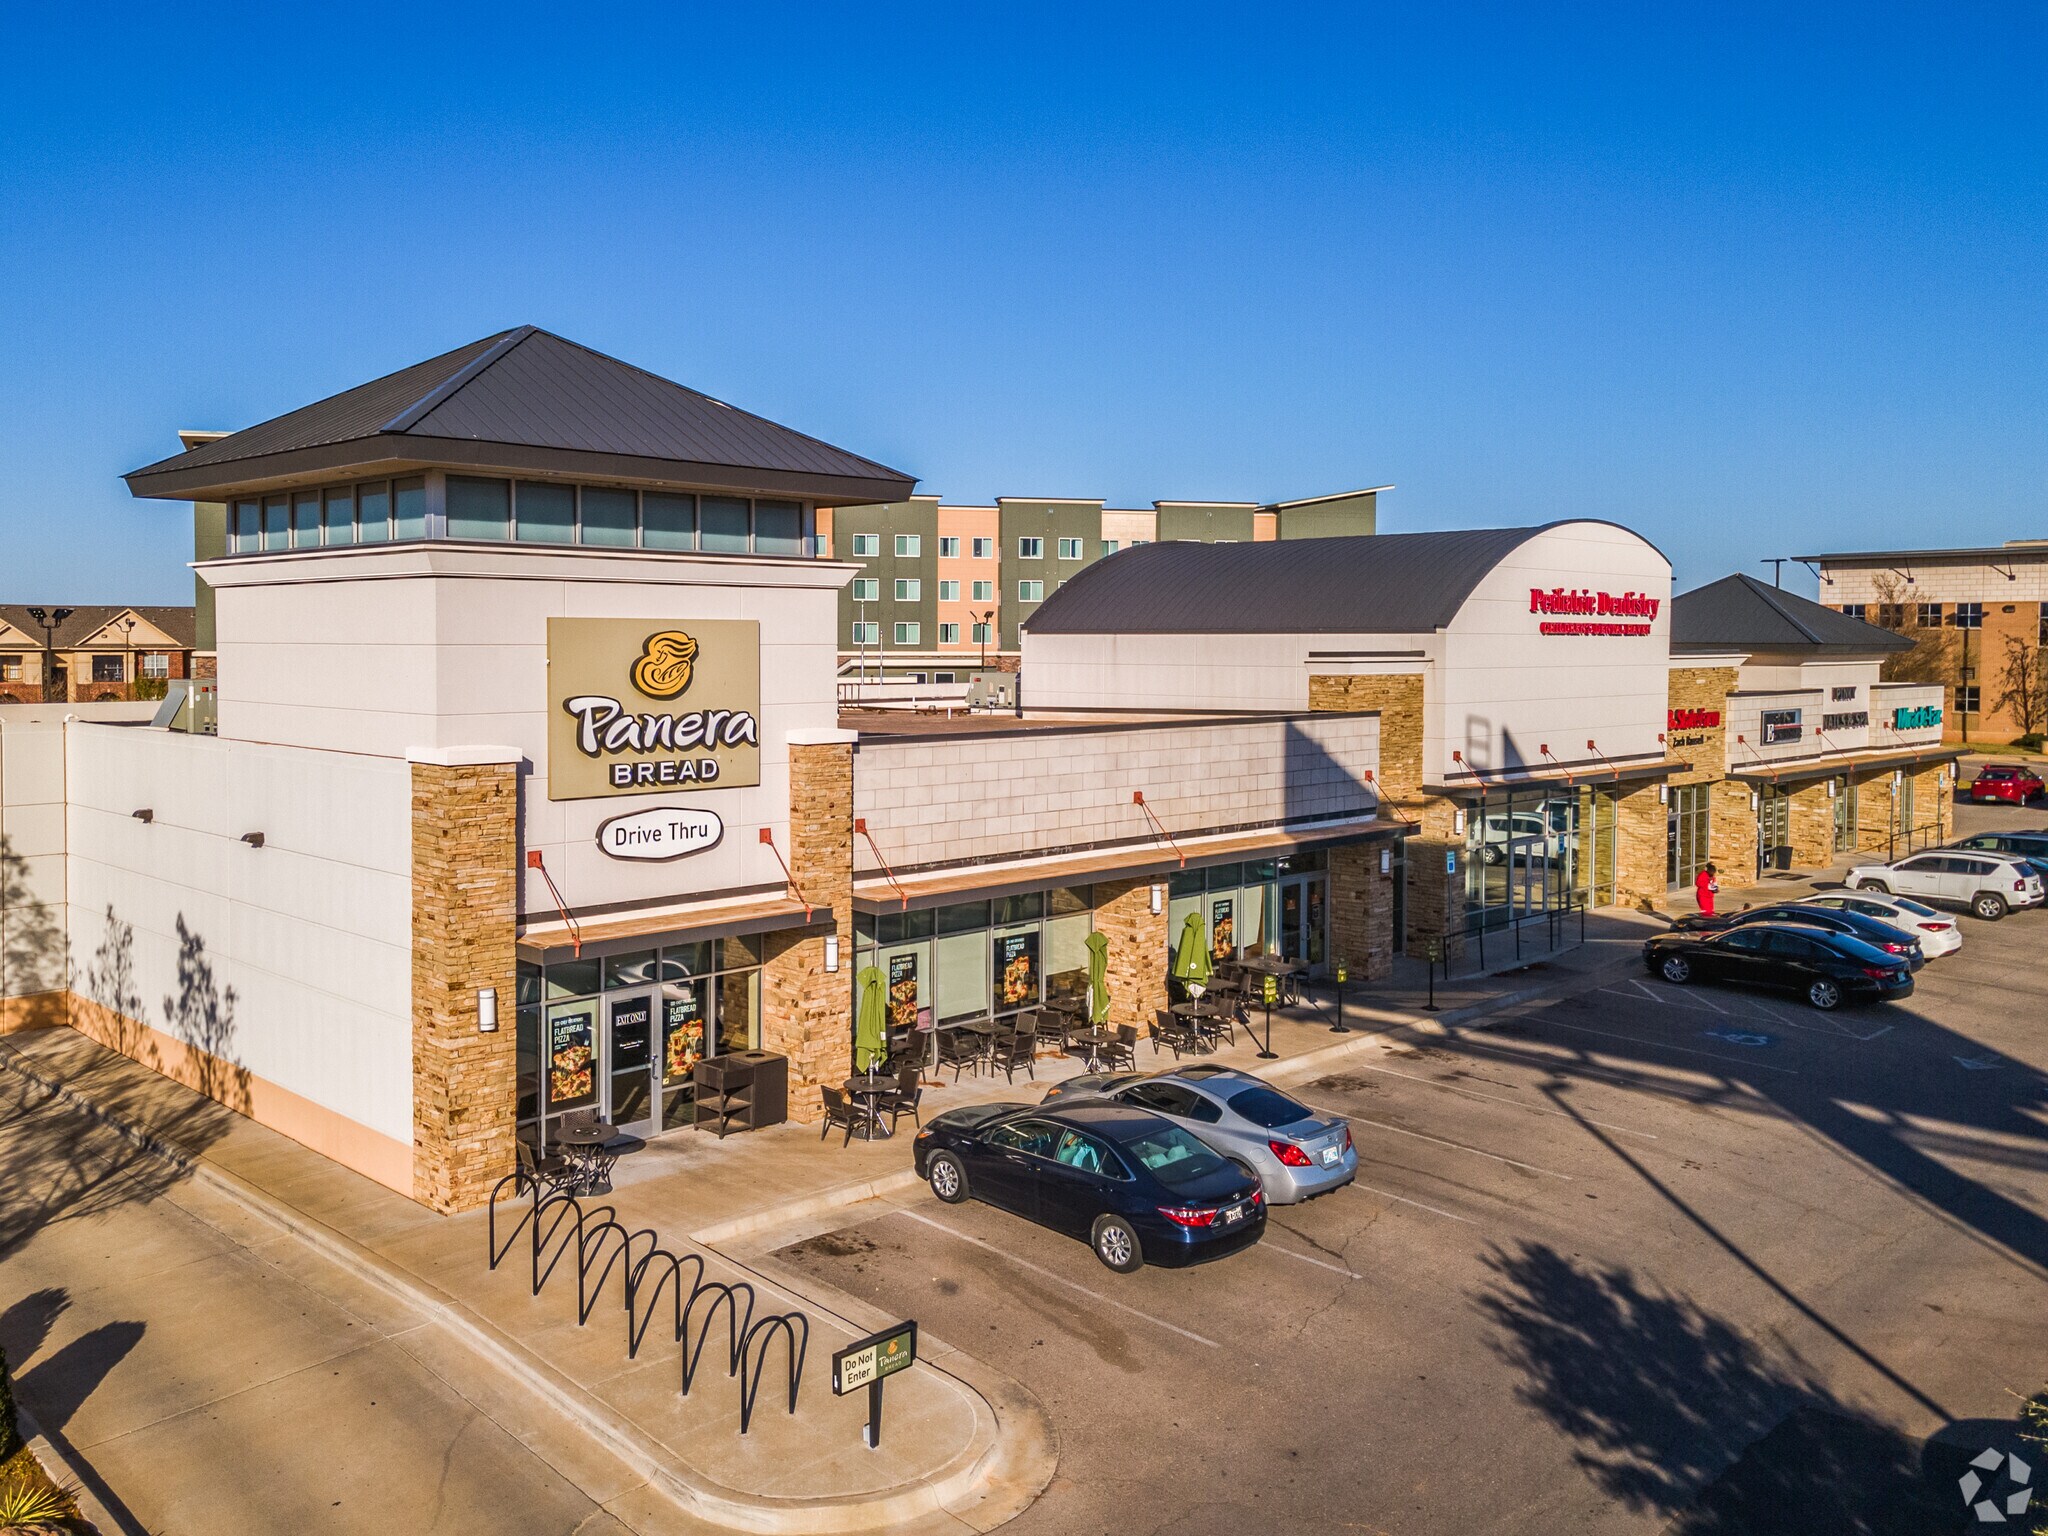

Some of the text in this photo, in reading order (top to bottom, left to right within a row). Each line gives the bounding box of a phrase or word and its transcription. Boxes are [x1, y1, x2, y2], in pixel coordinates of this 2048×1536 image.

[1529, 588, 1660, 622] Pediatric Dentistry
[563, 695, 760, 758] Panera
[1823, 713, 1847, 731] NAILS
[1855, 711, 1869, 728] SPA
[1895, 705, 1942, 731] Miracle-Ear
[609, 759, 720, 788] BREAD
[615, 821, 708, 846] Drive Thru
[616, 1011, 646, 1026] EXIT ONLY
[670, 1004, 697, 1015] FLATBREAD
[670, 1013, 684, 1023] PIZZA
[554, 1024, 583, 1036] FLATBREAD
[554, 1035, 570, 1044] PIZZA
[845, 1352, 873, 1371] Do Not
[879, 1350, 907, 1367] Panera
[847, 1367, 871, 1384] Enter
